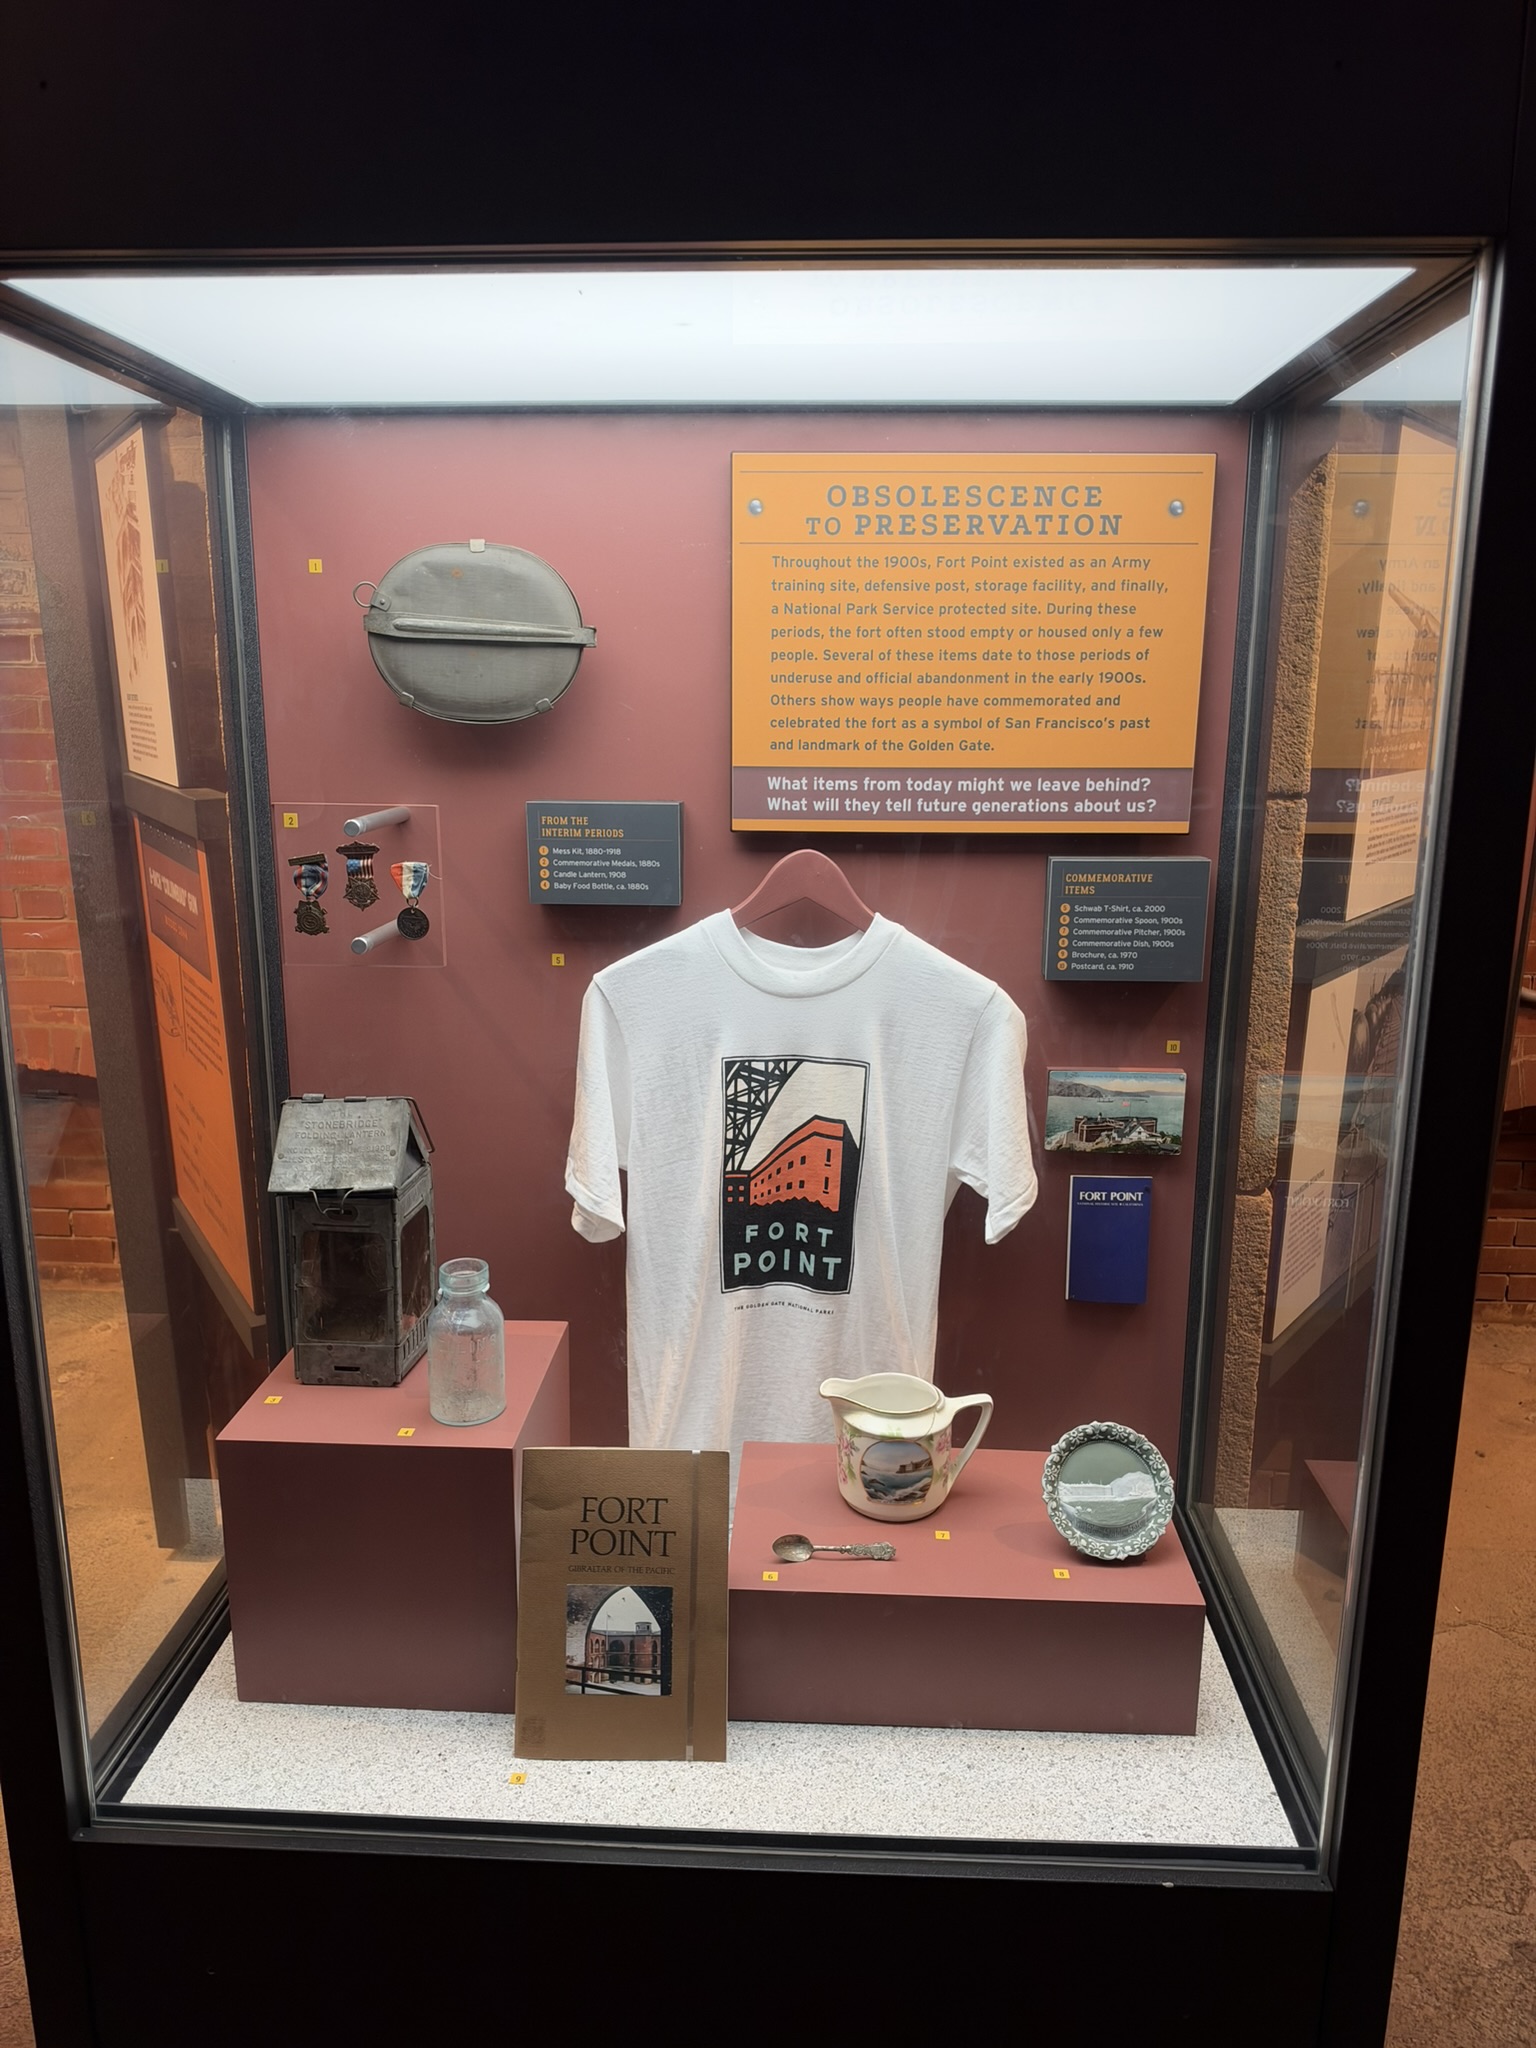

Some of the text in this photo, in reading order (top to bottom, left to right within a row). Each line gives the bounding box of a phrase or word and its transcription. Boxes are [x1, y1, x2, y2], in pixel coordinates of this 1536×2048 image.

[827, 485, 1102, 508] OBSOLESCENCE
[806, 514, 1123, 536] TO PRESERVATION
[772, 555, 1151, 571] Throughout the 1900s, Fort Point existed as an Army
[771, 579, 1168, 594] training site, defensive post, storage facility, and finally,
[771, 602, 1137, 617] a National Park Service protected site. During these
[771, 625, 1164, 641] periods, the fort often stood empty or housed only a few
[771, 648, 1150, 663] people. Several of these items date to those periods of
[771, 672, 1146, 686] underuse and official abandonment in the early 1900s.
[770, 694, 1121, 709] Others show ways people have commemorated and
[770, 717, 841, 728] celebrated
[845, 717, 867, 729] the
[872, 717, 897, 729] fort
[901, 720, 917, 729] as
[921, 720, 929, 729] a
[934, 717, 982, 732] symbol
[987, 717, 1001, 729] of
[1005, 717, 1031, 729] San
[1120, 717, 1151, 731] past
[770, 739, 994, 751] and landmark of the Golden Gate.
[767, 776, 1151, 795] What items from today might we leave behind?
[767, 797, 1157, 816] What will they tell future generations about us?
[541, 816, 588, 825] FROM THE
[542, 828, 624, 838] INTERIM PERIODS
[553, 859, 610, 867] Commemorative
[611, 860, 638, 868] Medals,
[553, 870, 627, 879] Candle Lantern, 1908
[1066, 873, 1153, 883] COMMEMORATIVE
[554, 882, 572, 890] Baby
[573, 882, 591, 890] Food
[592, 882, 615, 890] Bottle,
[1065, 886, 1095, 895] ITEMS
[1074, 904, 1103, 912] Schwab
[1104, 905, 1131, 913] T-Shirt,
[1144, 905, 1166, 913] 2000
[1073, 916, 1133, 924] Commemorative
[1134, 917, 1159, 925] Spoon,
[1072, 928, 1186, 936] Commemorative Pitcher, 1900s
[1072, 939, 1174, 948] Commemorative Dish, 1900s
[1072, 951, 1107, 959] Brochure,
[1120, 951, 1138, 959] 1970
[1071, 962, 1105, 971] Postcard,
[345, 1130, 386, 1139] LANTERN
[1079, 1191, 1144, 1202] FORT POINT
[746, 1222, 833, 1248] FORT
[734, 1249, 842, 1280] POINT
[580, 1496, 668, 1524] FORT
[570, 1528, 676, 1557] POINT
[568, 1565, 676, 1575] GIBRALTAR OF THE PACIFIC
